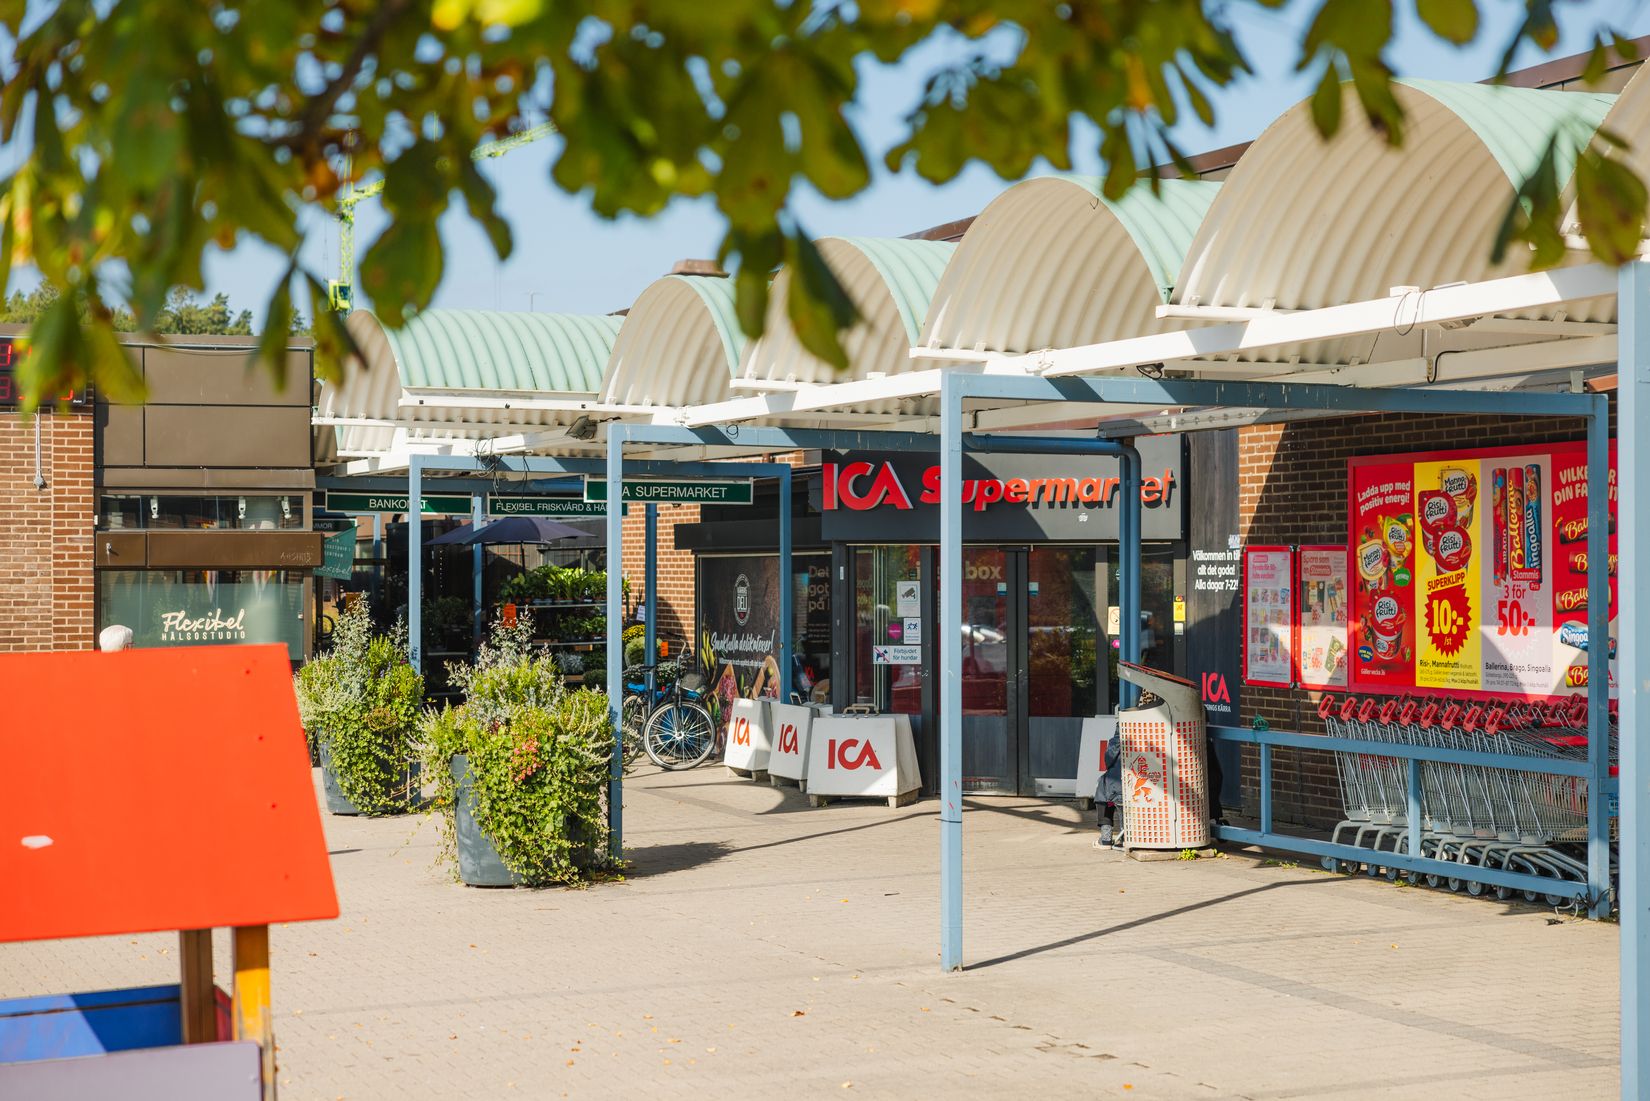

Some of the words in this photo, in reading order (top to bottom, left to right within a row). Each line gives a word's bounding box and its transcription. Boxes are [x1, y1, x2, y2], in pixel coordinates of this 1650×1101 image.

[635, 486, 727, 498] SUPERMARKET
[823, 461, 913, 511] ICA
[920, 466, 1175, 512] Supermaret
[1358, 485, 1379, 502] Ladda
[1380, 483, 1394, 494] upp
[1395, 480, 1411, 491] med
[1554, 484, 1574, 506] DIN
[369, 499, 427, 509] BANKOT
[496, 502, 535, 512] FLEXIBEL
[537, 501, 584, 512] FRISKVÅRD
[585, 503, 592, 512] &
[1360, 495, 1384, 517] positiv
[1385, 492, 1410, 506] energi!
[1509, 479, 1525, 569] Ballerina
[1526, 508, 1541, 569] ingoalla
[1192, 550, 1226, 561] Välkommen
[1226, 550, 1233, 561] in
[965, 561, 1001, 579] box
[1197, 564, 1206, 576] allt
[1207, 564, 1217, 576] det
[1217, 564, 1235, 577] goda!
[1513, 570, 1540, 579] Stammis
[1194, 579, 1207, 590] Alla
[1207, 579, 1225, 592] dagar
[1225, 579, 1239, 591] 7-22!
[1427, 572, 1466, 591] SUPERKLIPP
[1504, 585, 1510, 599] 3
[1511, 584, 1526, 599] för
[1379, 600, 1392, 609] Risi
[161, 608, 245, 632] Flexibel
[1432, 598, 1464, 635] 10:-
[1497, 600, 1536, 637] 50:-
[893, 647, 918, 655] Förbjudet
[901, 653, 918, 661] hundar
[1485, 662, 1509, 671] Ballerina,
[1201, 671, 1231, 703] ICA
[733, 717, 751, 747] ICA
[778, 724, 799, 755] ICA
[827, 738, 882, 770] ICA
